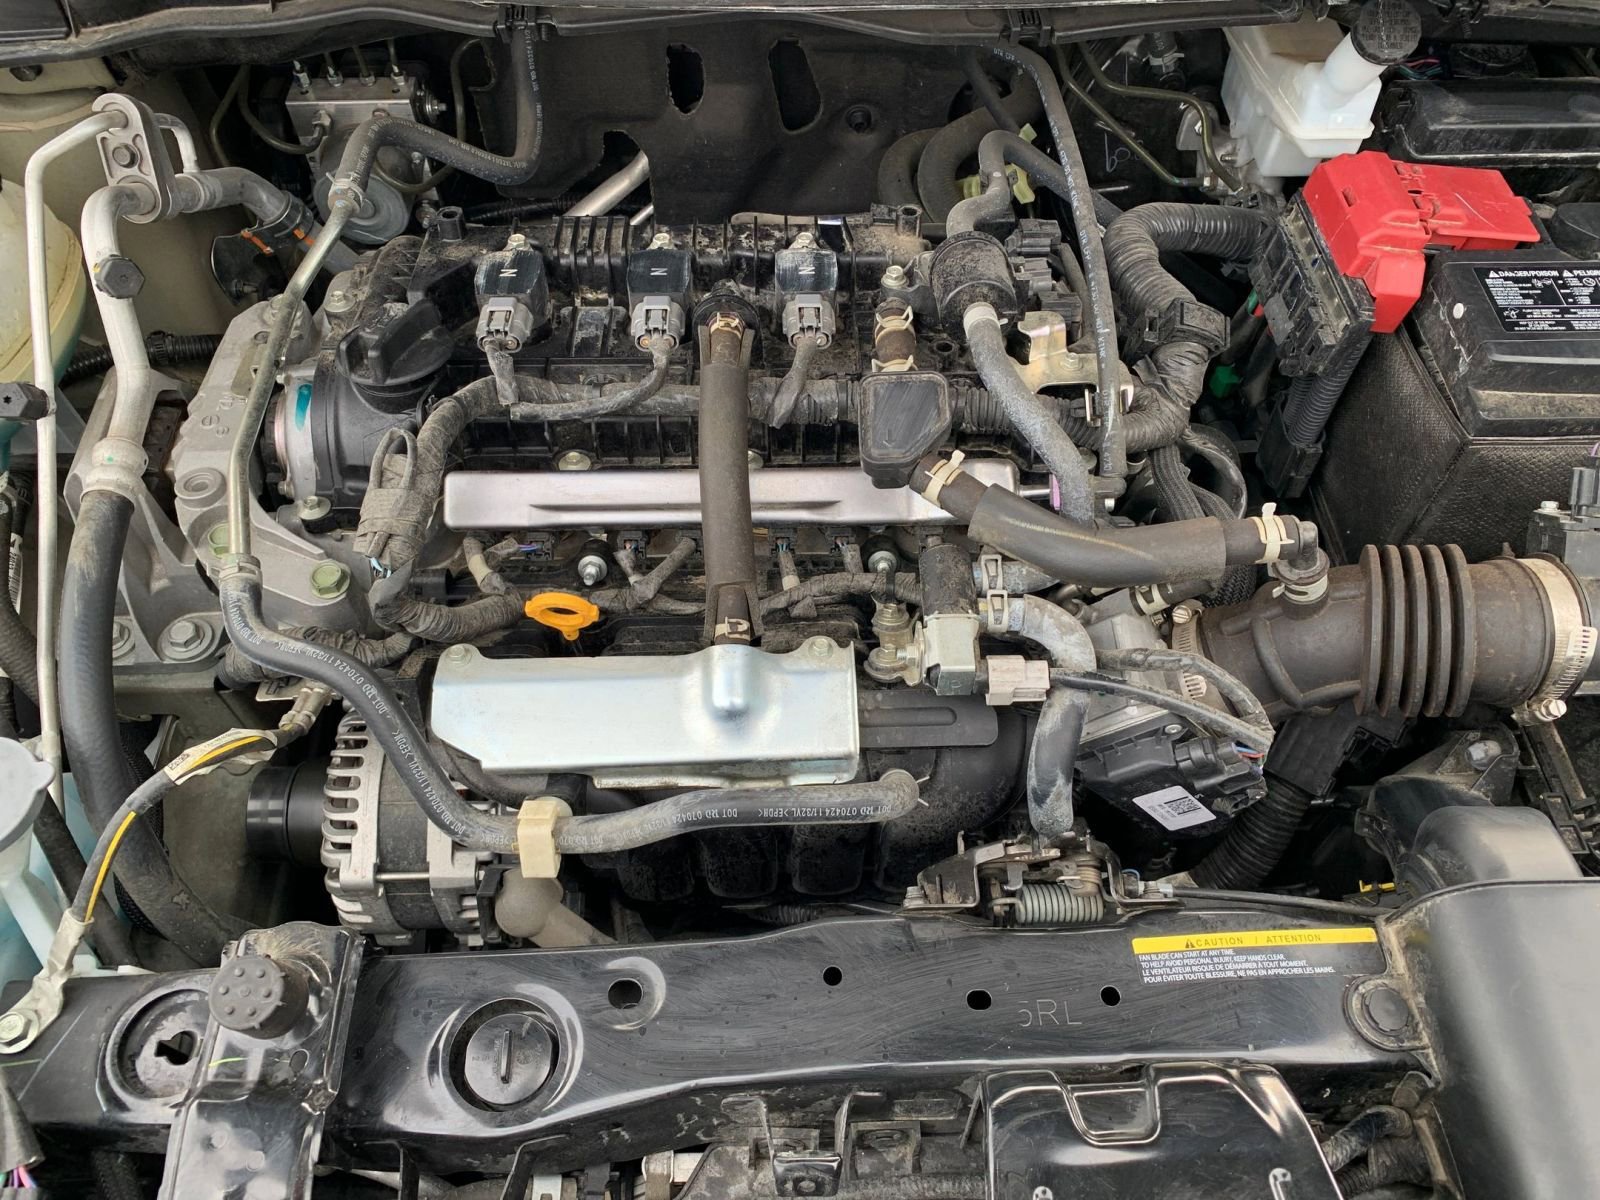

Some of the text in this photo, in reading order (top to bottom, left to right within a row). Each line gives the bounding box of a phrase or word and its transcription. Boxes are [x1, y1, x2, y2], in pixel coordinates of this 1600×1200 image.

[333, 660, 364, 684] 070424
[374, 699, 388, 714] DOT
[423, 787, 443, 813] 070424
[722, 807, 738, 818] DOT
[824, 806, 857, 817] 070424
[1196, 936, 1244, 947] CAUTION
[1266, 933, 1322, 944] ATTENTION
[1139, 954, 1150, 962] FAN
[1151, 953, 1169, 961] BLADE
[1170, 952, 1182, 960] CAN
[1183, 951, 1201, 959] START
[1141, 961, 1149, 969] TO
[1150, 960, 1165, 968] HELP
[1165, 959, 1183, 967] AVOID
[1183, 957, 1213, 966] PERSONAL
[1150, 966, 1192, 976] VENTILATEUR
[1192, 965, 1215, 973] RISQUE
[1225, 961, 1257, 970] DÉMARRER
[1163, 974, 1184, 982] ÉVITER
[1184, 972, 1205, 980] TOUTE
[1237, 969, 1246, 977] NE
[1258, 968, 1267, 976] EN
[1267, 966, 1304, 975] APPROCHER
